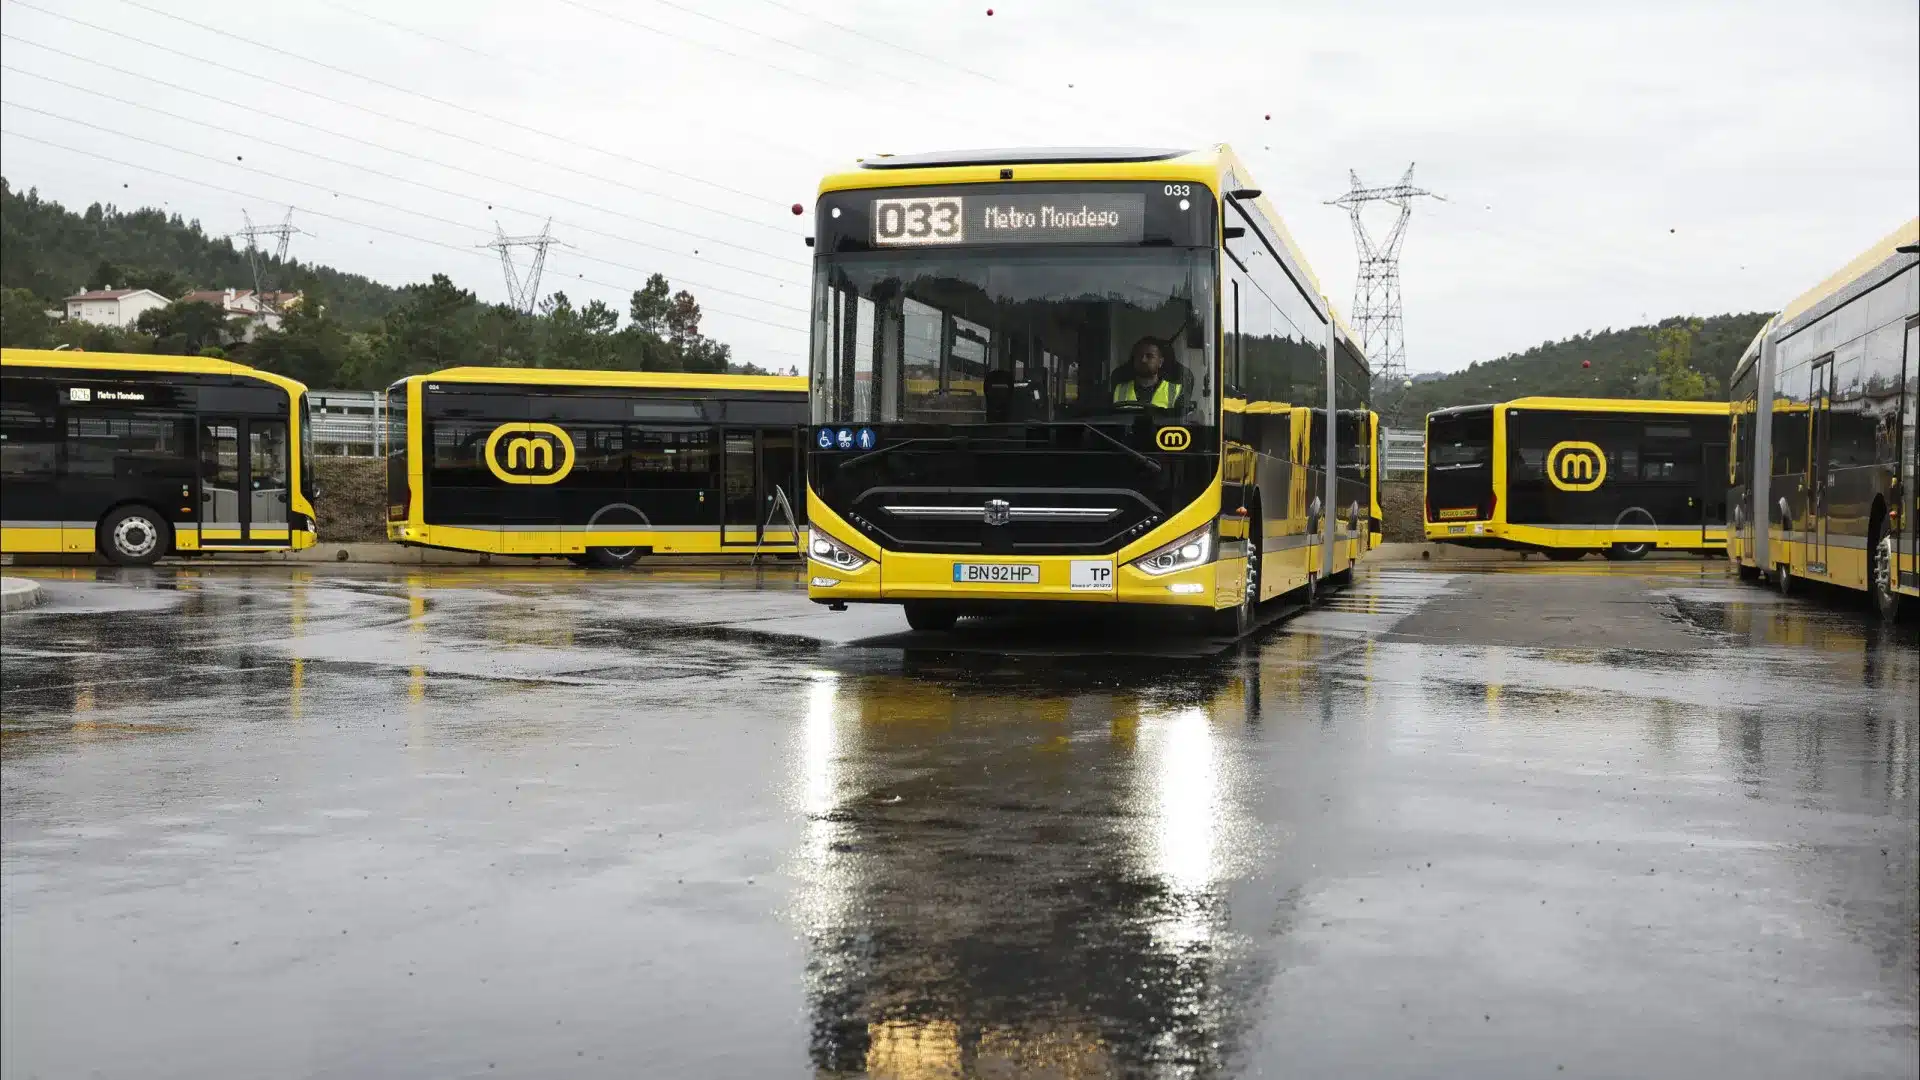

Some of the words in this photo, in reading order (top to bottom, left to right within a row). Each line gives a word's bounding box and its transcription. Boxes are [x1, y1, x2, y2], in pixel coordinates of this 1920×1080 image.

[1163, 184, 1191, 197] 033
[877, 201, 961, 239] 033
[984, 205, 1036, 229] Metro
[1040, 204, 1119, 228] Mondego
[97, 391, 116, 400] Metro
[968, 565, 1032, 581] BN92HP
[1090, 568, 1111, 581] TP
